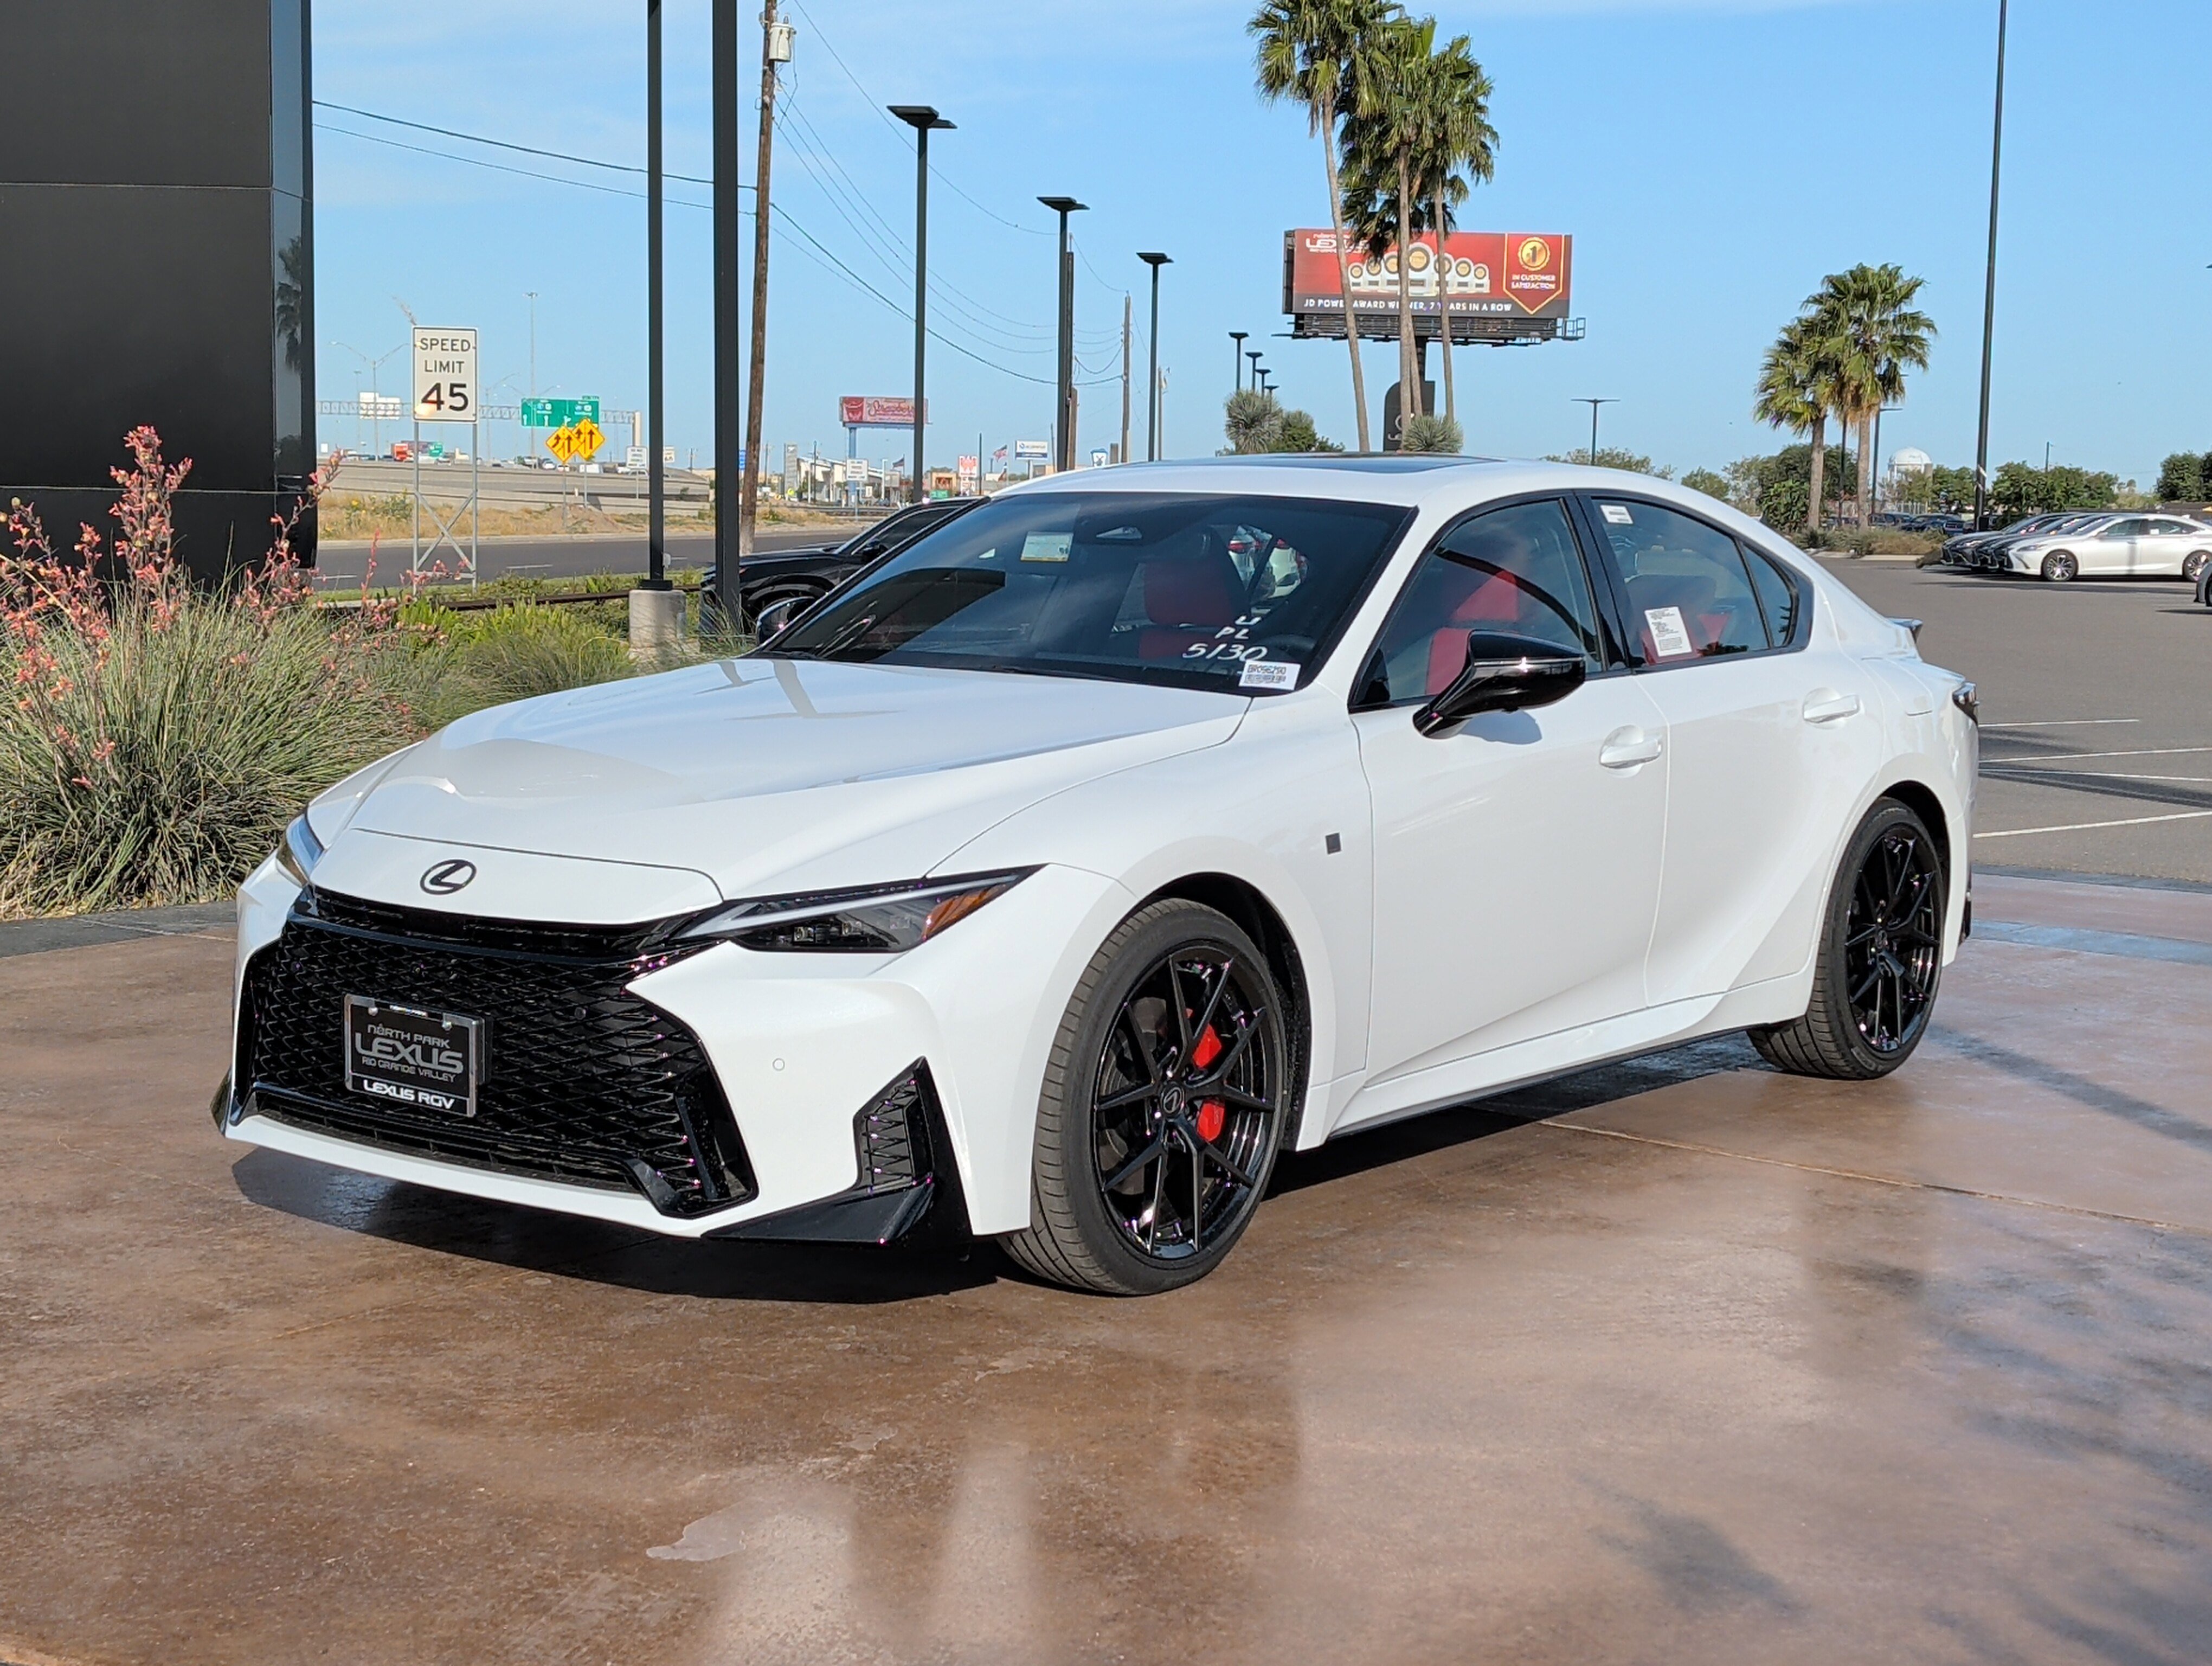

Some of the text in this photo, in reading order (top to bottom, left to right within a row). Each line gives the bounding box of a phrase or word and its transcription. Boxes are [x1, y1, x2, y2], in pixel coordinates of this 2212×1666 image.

[1303, 298, 1315, 307] JD
[1317, 299, 1345, 309] POWE
[1352, 299, 1385, 309] AWARD
[1429, 302, 1436, 310] 7
[1469, 303, 1479, 311] IN
[1490, 303, 1513, 312] ROW
[420, 337, 471, 352] SPEED
[424, 359, 465, 374] LIMIT
[421, 382, 469, 412] 45
[1214, 626, 1250, 640] PL
[367, 1023, 451, 1049] NORTH PARK
[354, 1032, 464, 1074] LEXUS
[361, 1056, 456, 1082] RIO GRANDE VALLEY
[363, 1079, 455, 1110] LEXUS RGV
